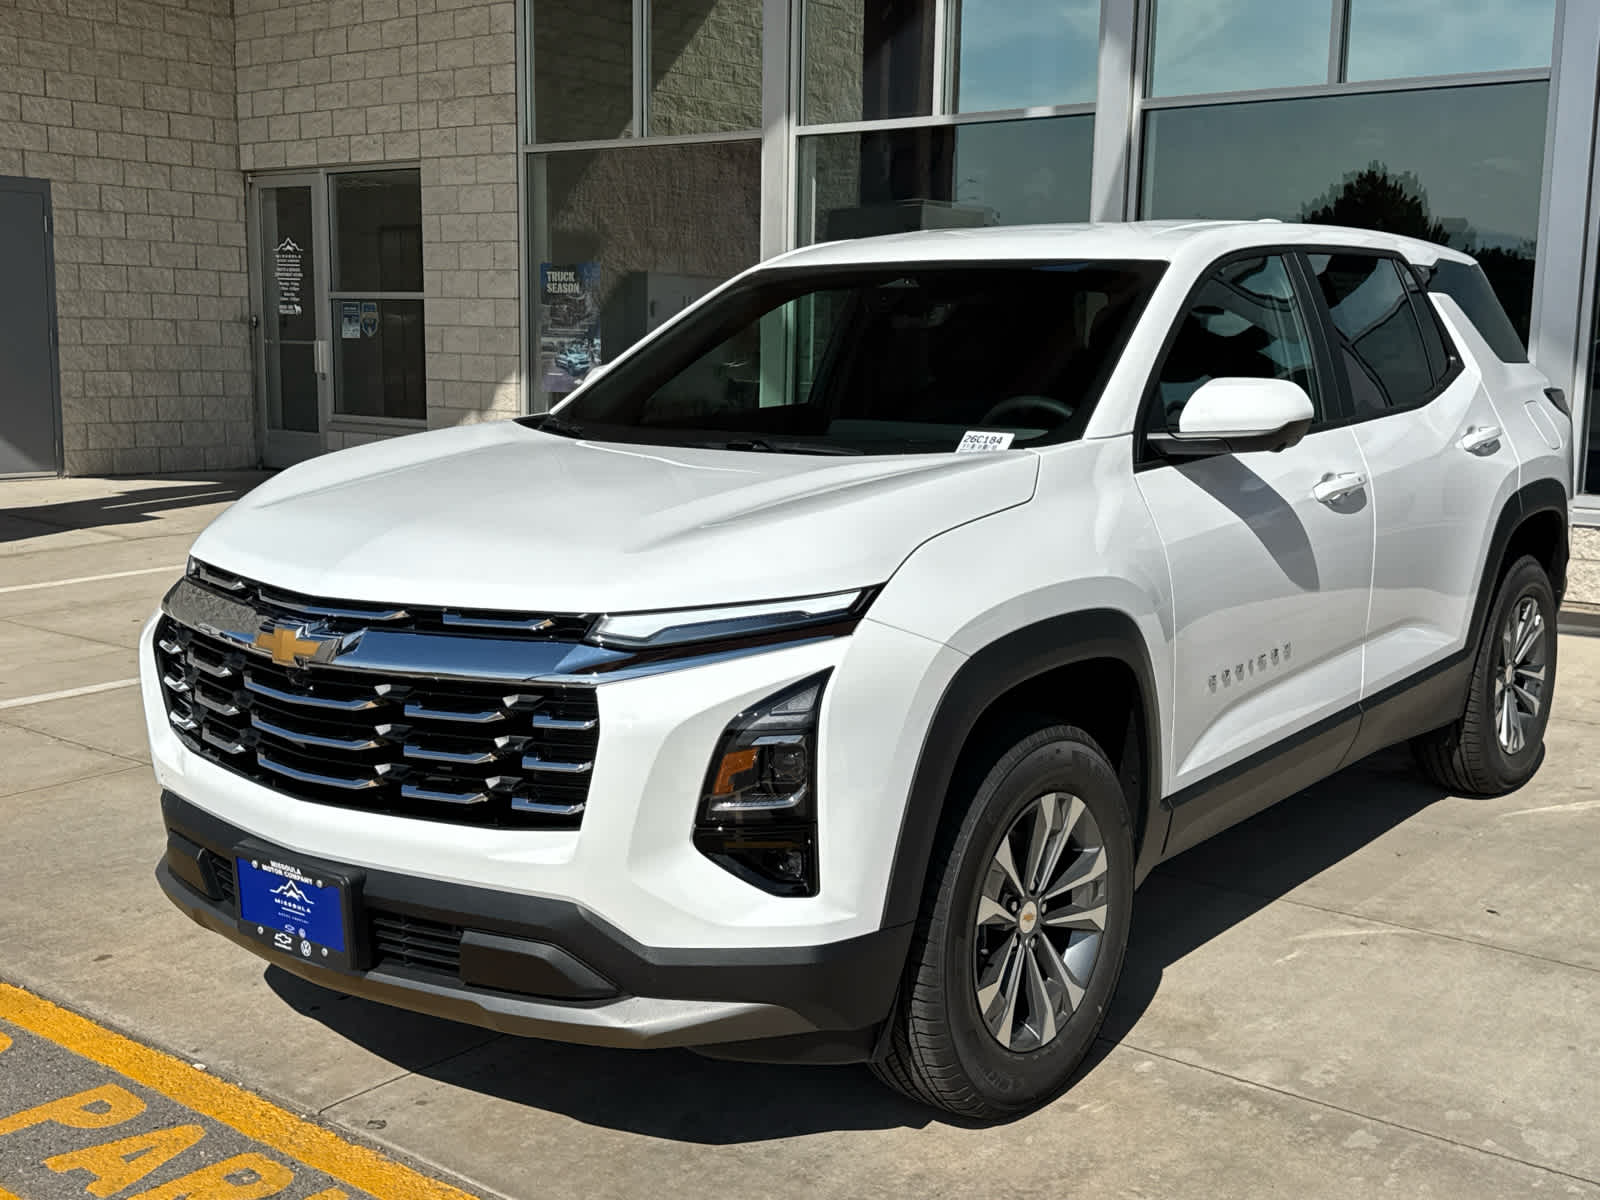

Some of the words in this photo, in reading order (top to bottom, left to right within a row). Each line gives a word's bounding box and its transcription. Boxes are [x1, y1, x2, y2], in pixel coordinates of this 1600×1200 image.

[546, 272, 575, 282] TRUCK
[546, 283, 580, 293] SEASON
[963, 435, 1003, 444] 26C184
[270, 860, 301, 874] MISSOULA
[261, 864, 283, 876] MOTOR
[284, 871, 313, 885] COMPANY
[274, 897, 311, 913] MISSOULA
[0, 1084, 350, 1200] PAR
